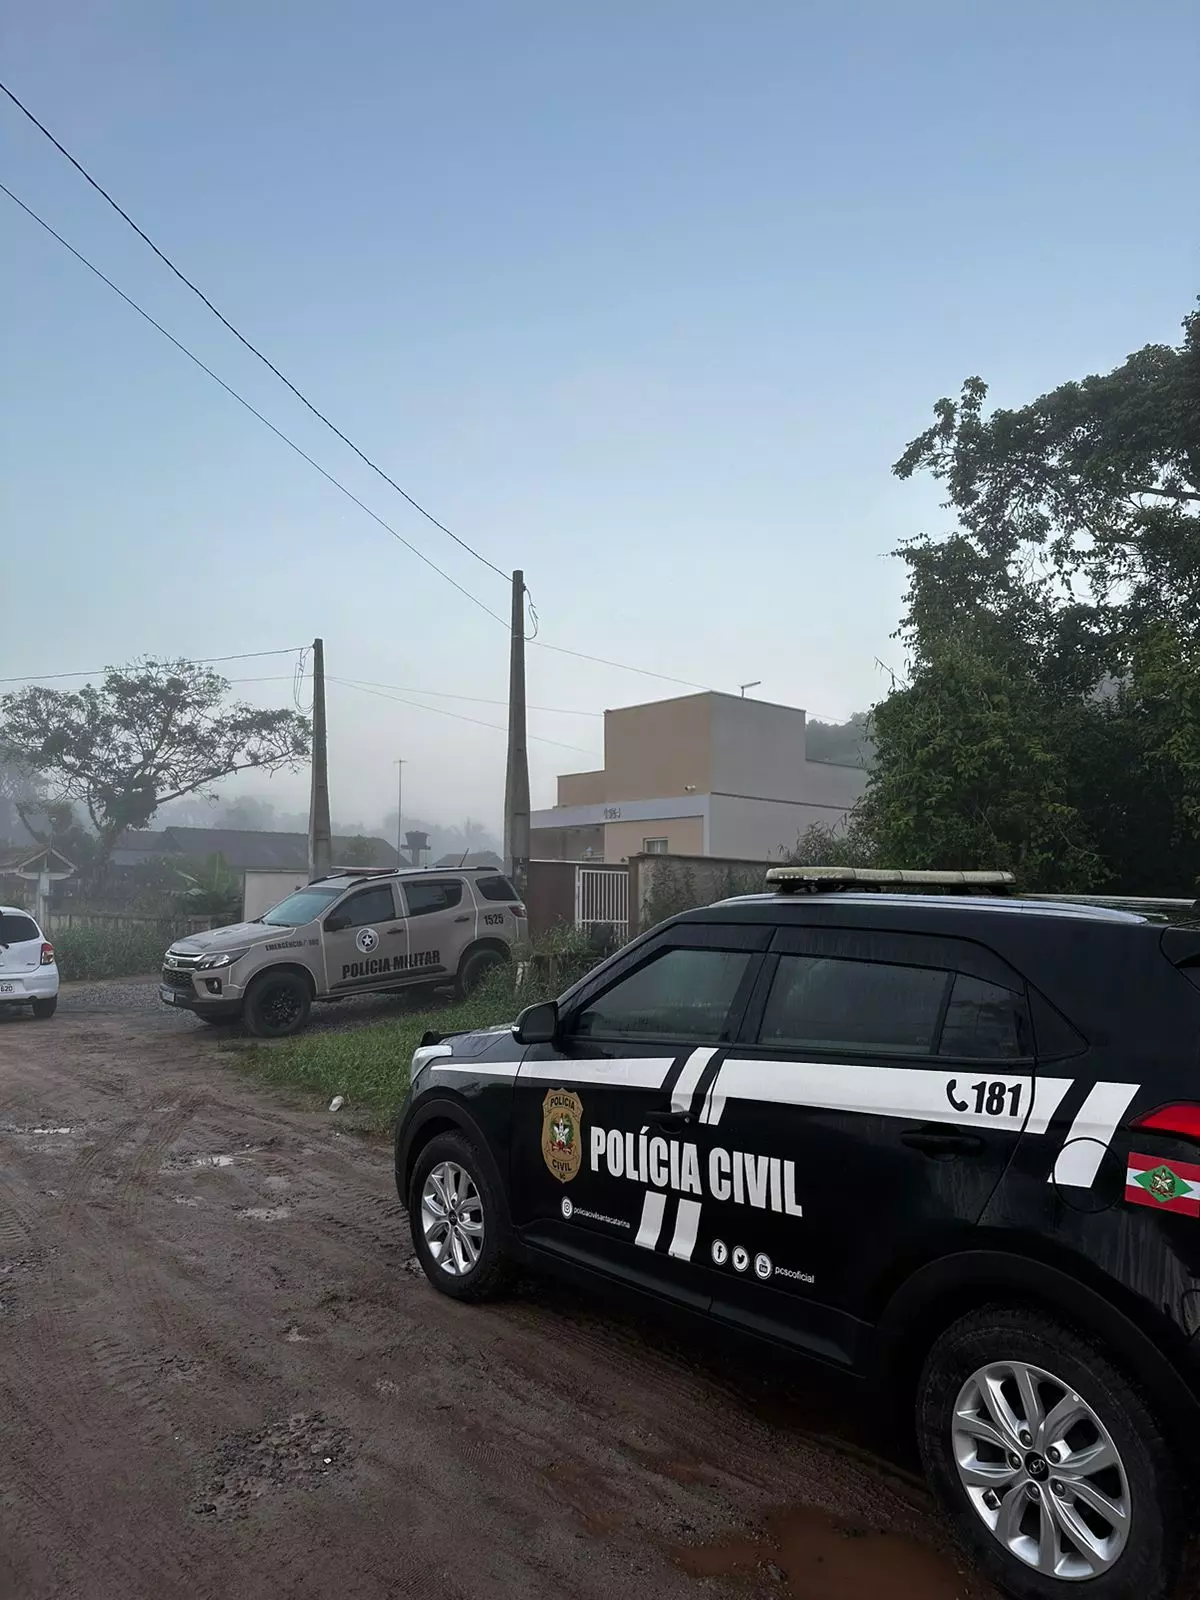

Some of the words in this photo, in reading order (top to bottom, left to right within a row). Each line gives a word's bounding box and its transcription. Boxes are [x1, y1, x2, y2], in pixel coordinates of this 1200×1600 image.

[484, 913, 504, 926] 1525
[342, 957, 391, 979] POLÍCIA
[393, 950, 440, 970] MILITAR
[971, 1081, 1022, 1116] 181
[552, 1159, 572, 1172] CIVIL
[590, 1126, 702, 1195] POLÍCIA
[708, 1147, 803, 1217] CIVIL
[775, 1266, 815, 1283] pcscoficial
